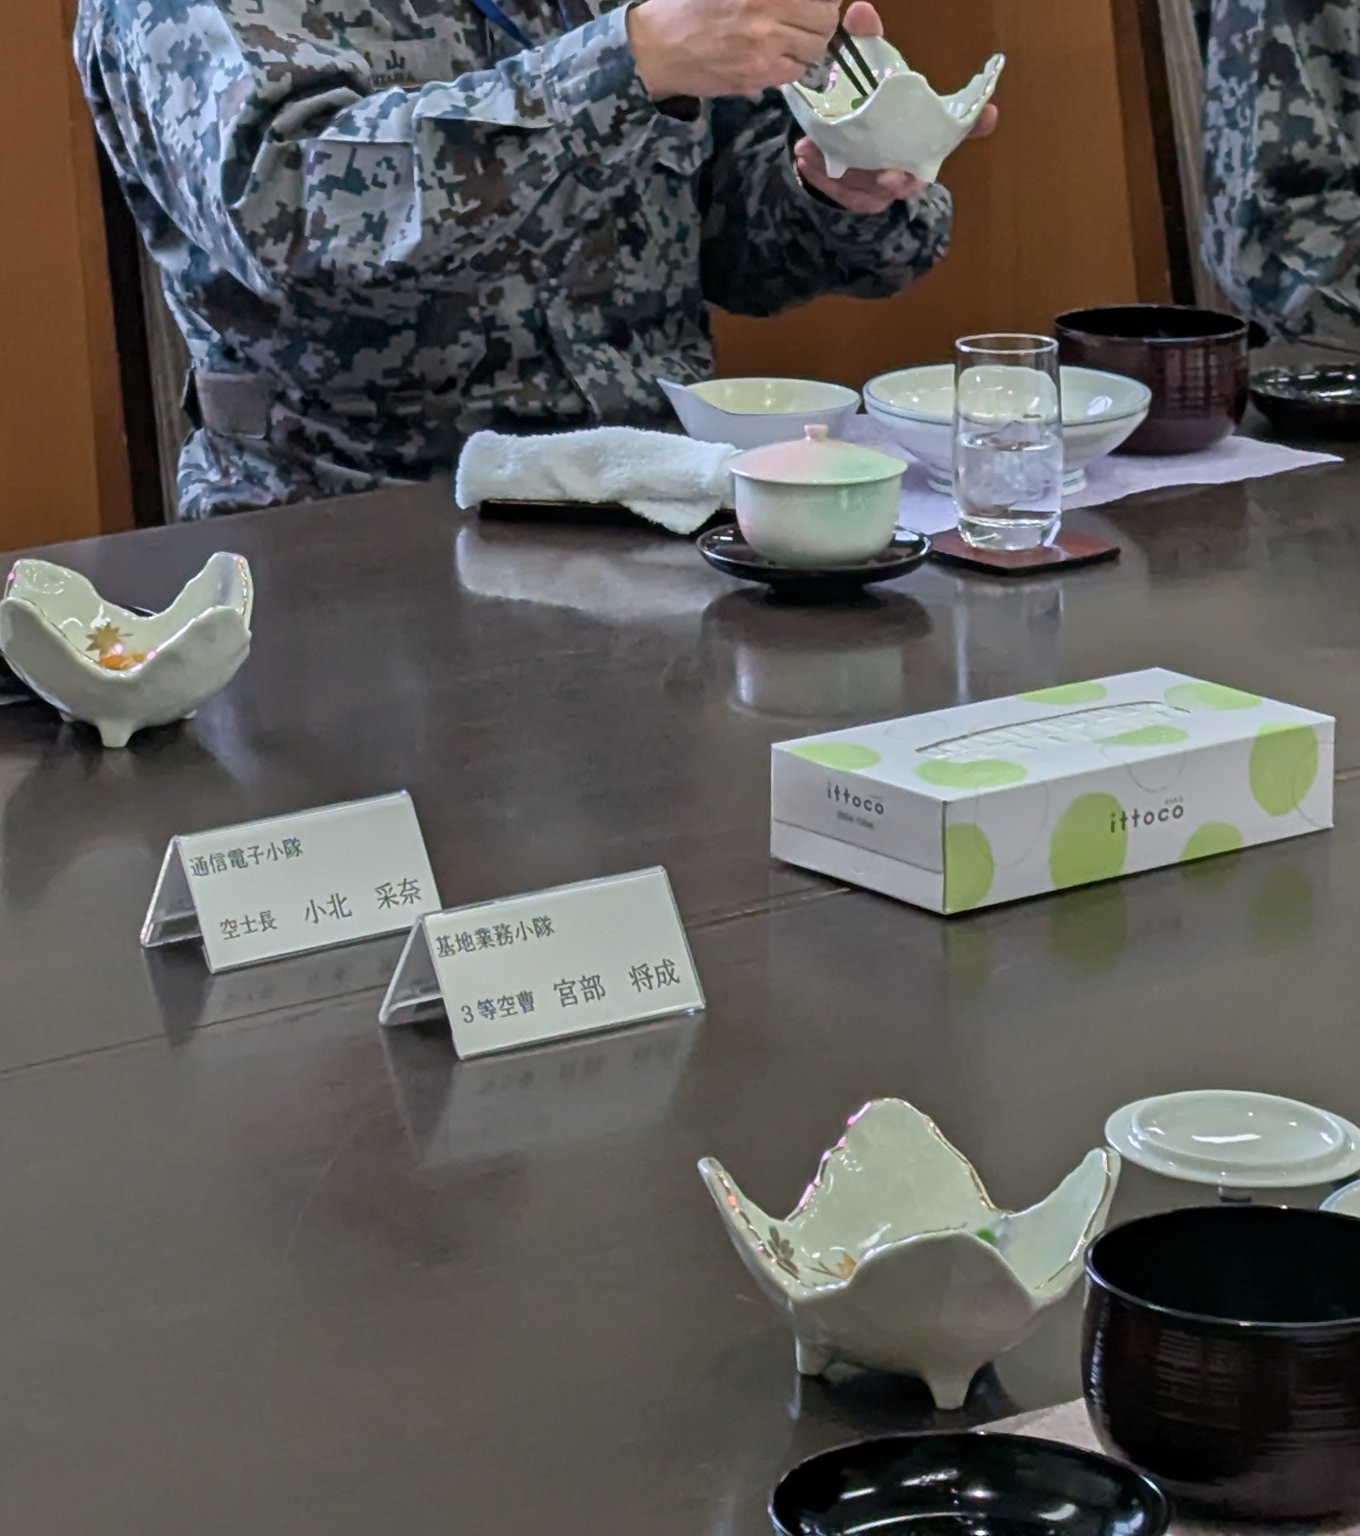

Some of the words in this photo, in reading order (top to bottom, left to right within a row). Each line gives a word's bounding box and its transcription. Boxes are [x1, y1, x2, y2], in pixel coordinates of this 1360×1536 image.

[827, 781, 885, 816] ittoco
[1110, 804, 1185, 834] ittoco
[189, 837, 305, 878] 通信電子小隊
[219, 909, 278, 941] 空士長
[303, 893, 354, 925] 小北
[374, 877, 423, 910] 采奈
[435, 915, 556, 958] 基地業務小隊
[460, 990, 536, 1024] 3等空曹
[553, 974, 608, 1008] 宮部
[627, 958, 681, 993] 将成
